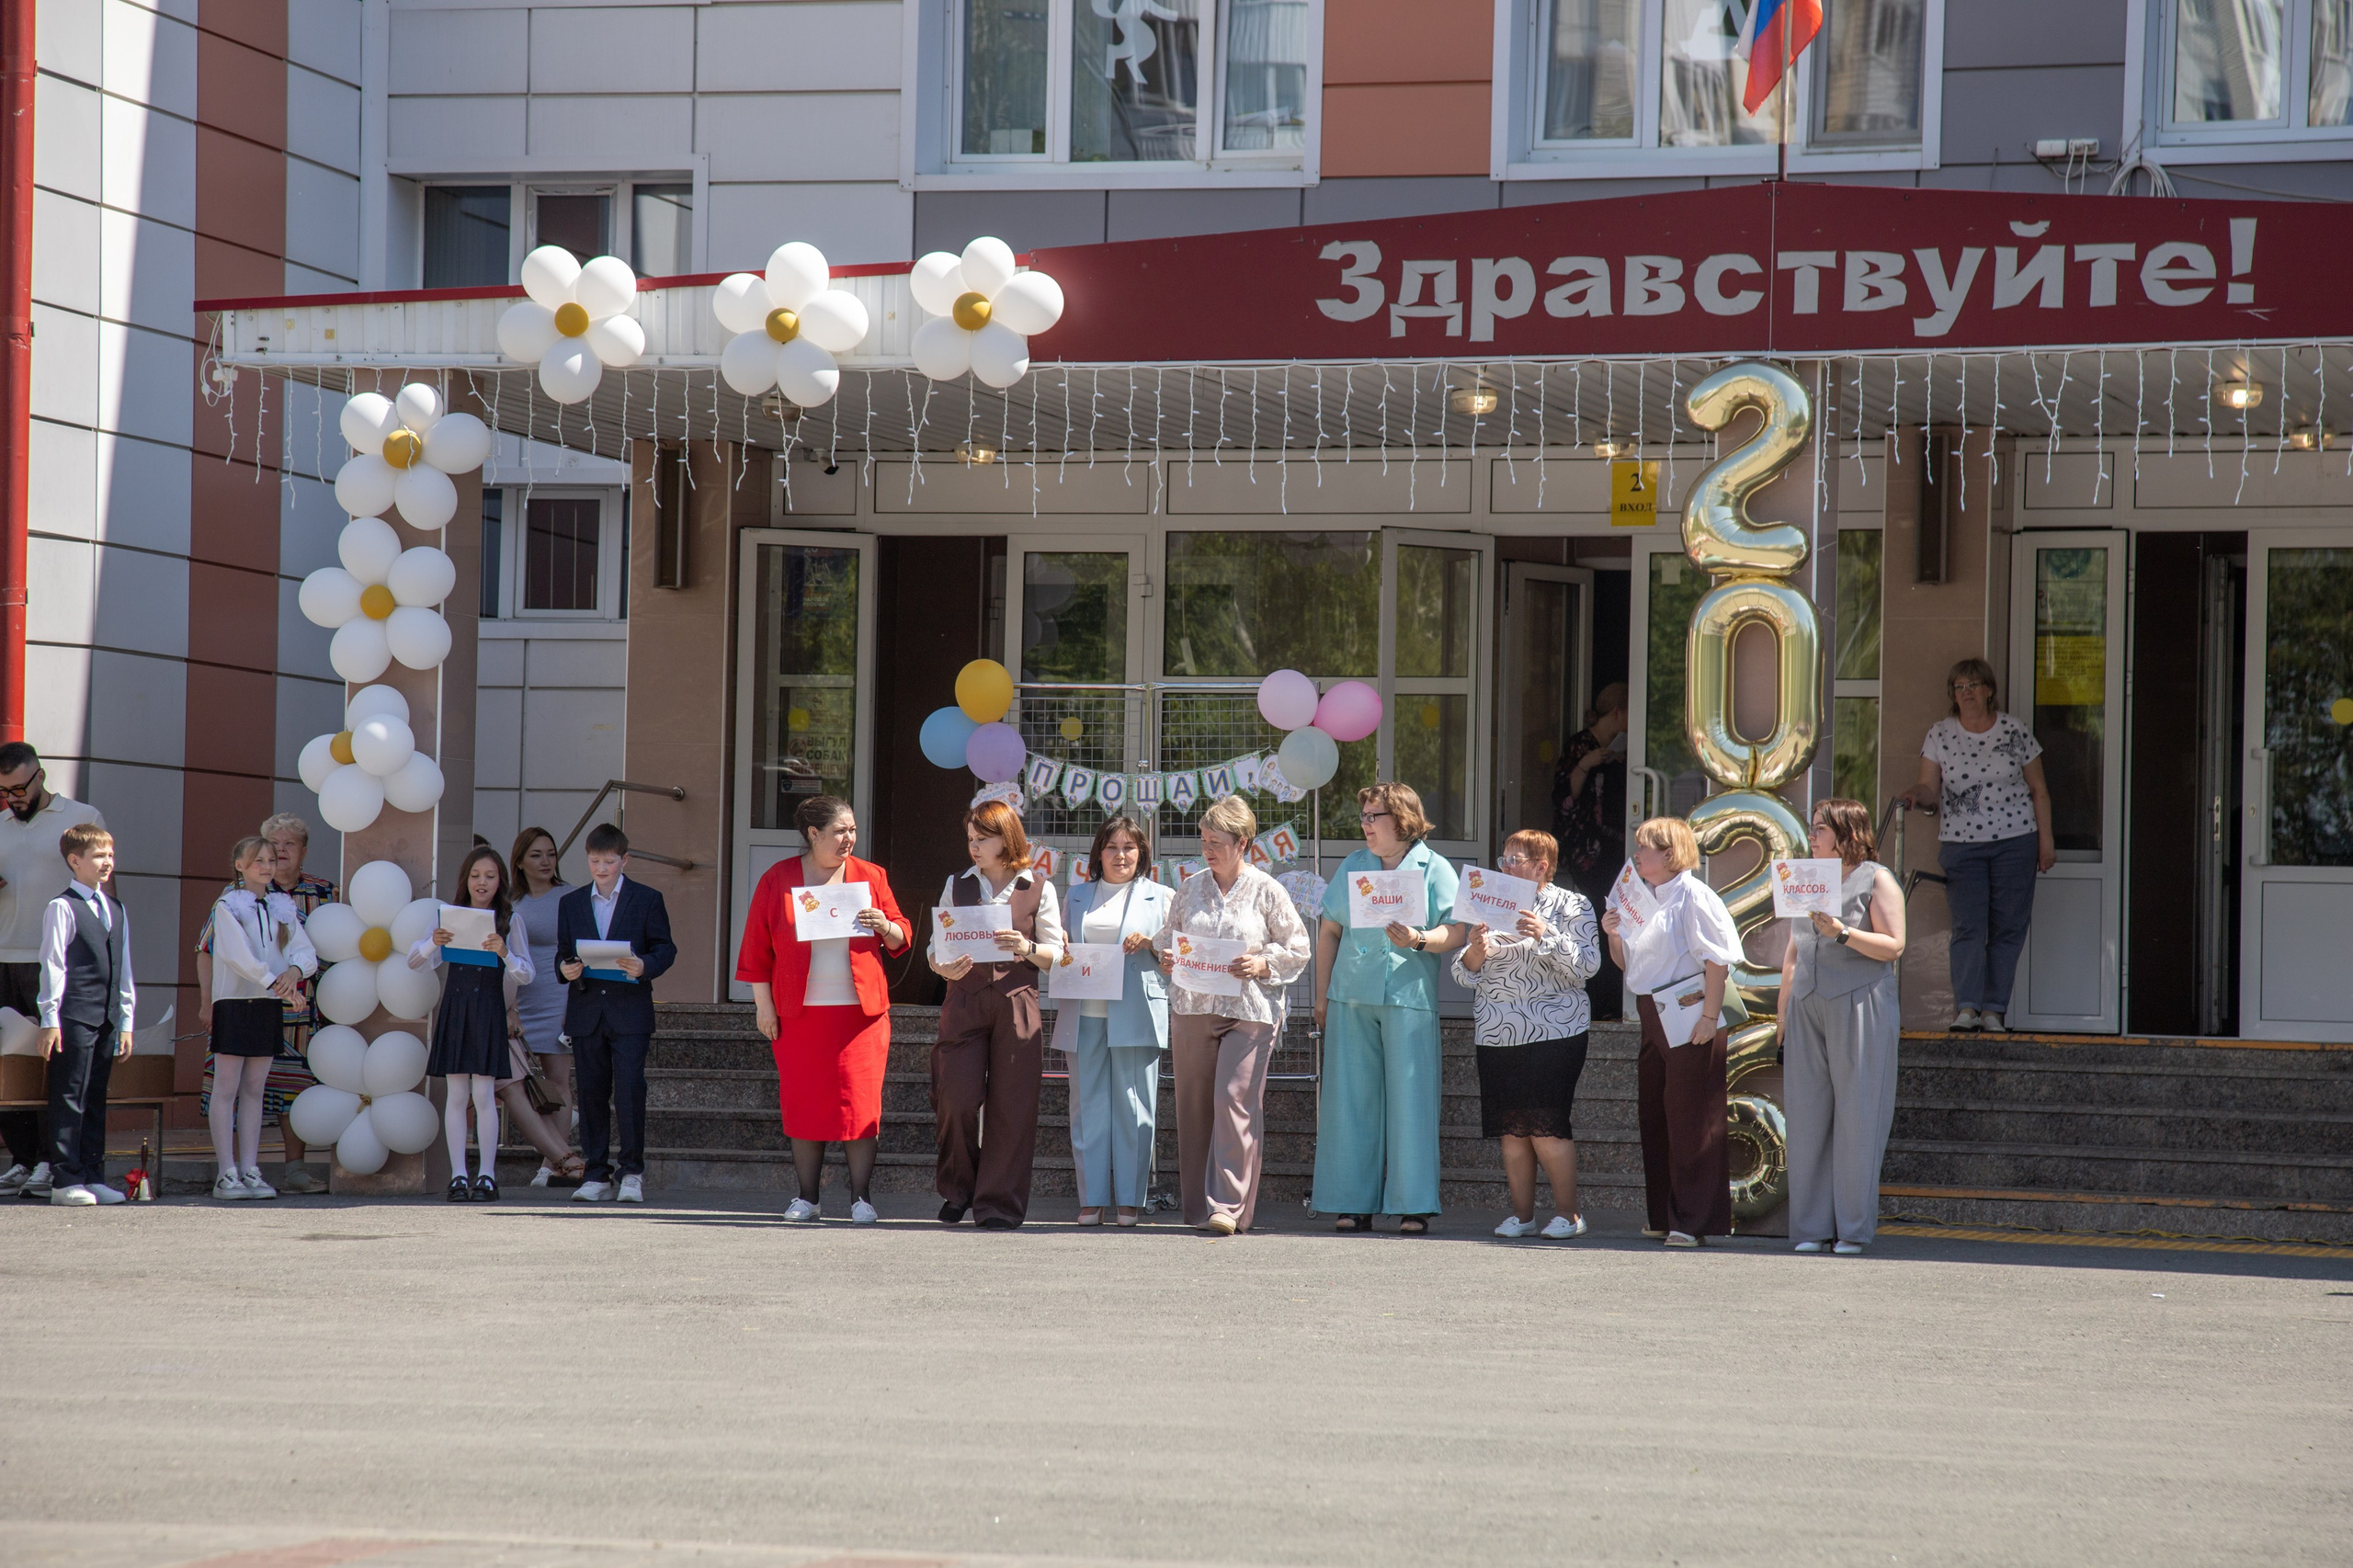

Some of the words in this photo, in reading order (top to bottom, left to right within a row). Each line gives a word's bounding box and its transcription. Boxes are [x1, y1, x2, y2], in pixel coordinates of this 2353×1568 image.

[1315, 216, 2260, 344] Здравствуйте!
[1631, 472, 1643, 492] 2
[1620, 502, 1653, 513] ВХОД
[806, 736, 847, 747] ВЫГУЛ
[805, 749, 847, 761] СОБАК
[1295, 875, 1315, 888] УРА!
[1783, 883, 1829, 894] КЛАССОВ.
[1290, 892, 1319, 904] ТУПЕНЬ!
[1371, 894, 1404, 905] ВАШИ
[1471, 891, 1518, 911] УЧИТЕЛЯ
[829, 907, 838, 917] С
[1082, 965, 1091, 977] И
